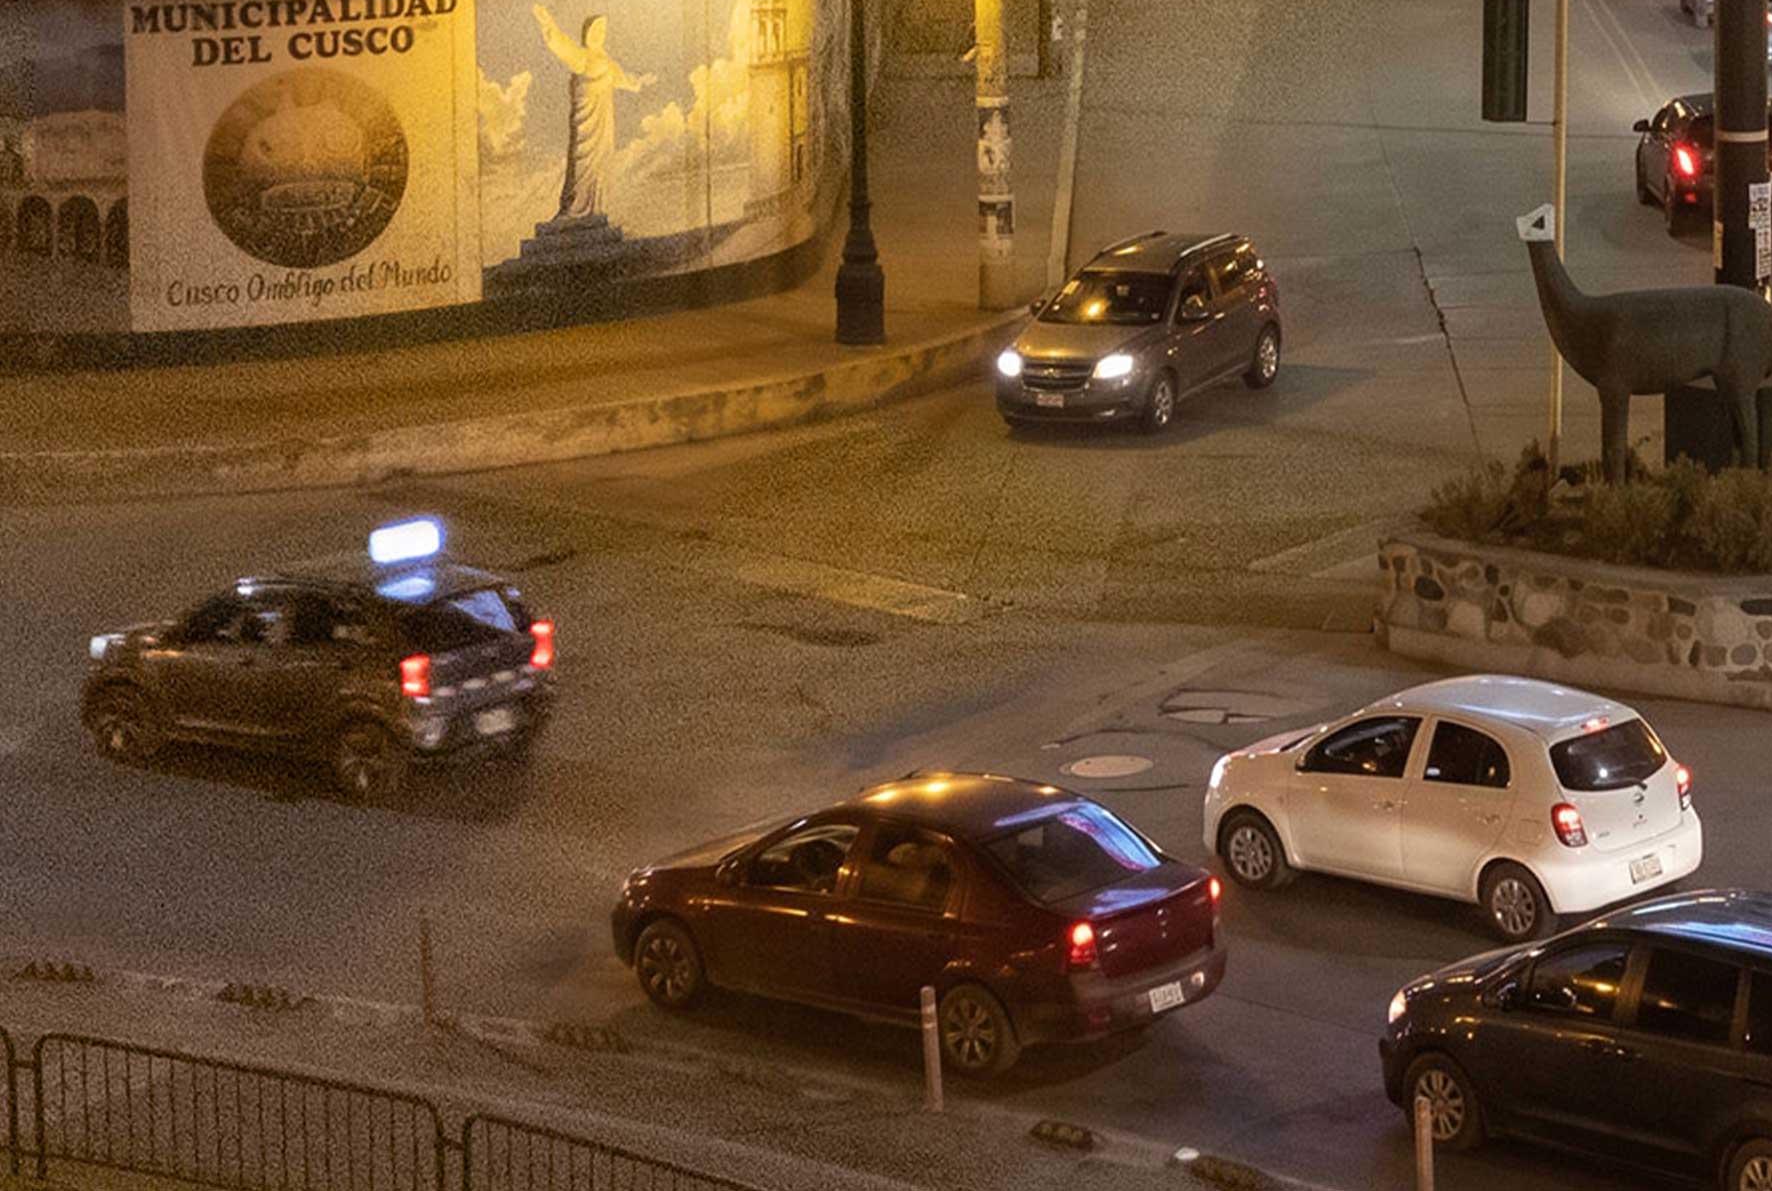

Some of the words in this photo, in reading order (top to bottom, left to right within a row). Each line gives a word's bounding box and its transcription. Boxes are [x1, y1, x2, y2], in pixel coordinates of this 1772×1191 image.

[192, 35, 272, 68] DEL
[287, 25, 415, 60] CUSCO
[166, 279, 240, 308] Cusco
[246, 271, 335, 308] Ombligo
[340, 263, 375, 292] del
[378, 257, 452, 288] Mundo
